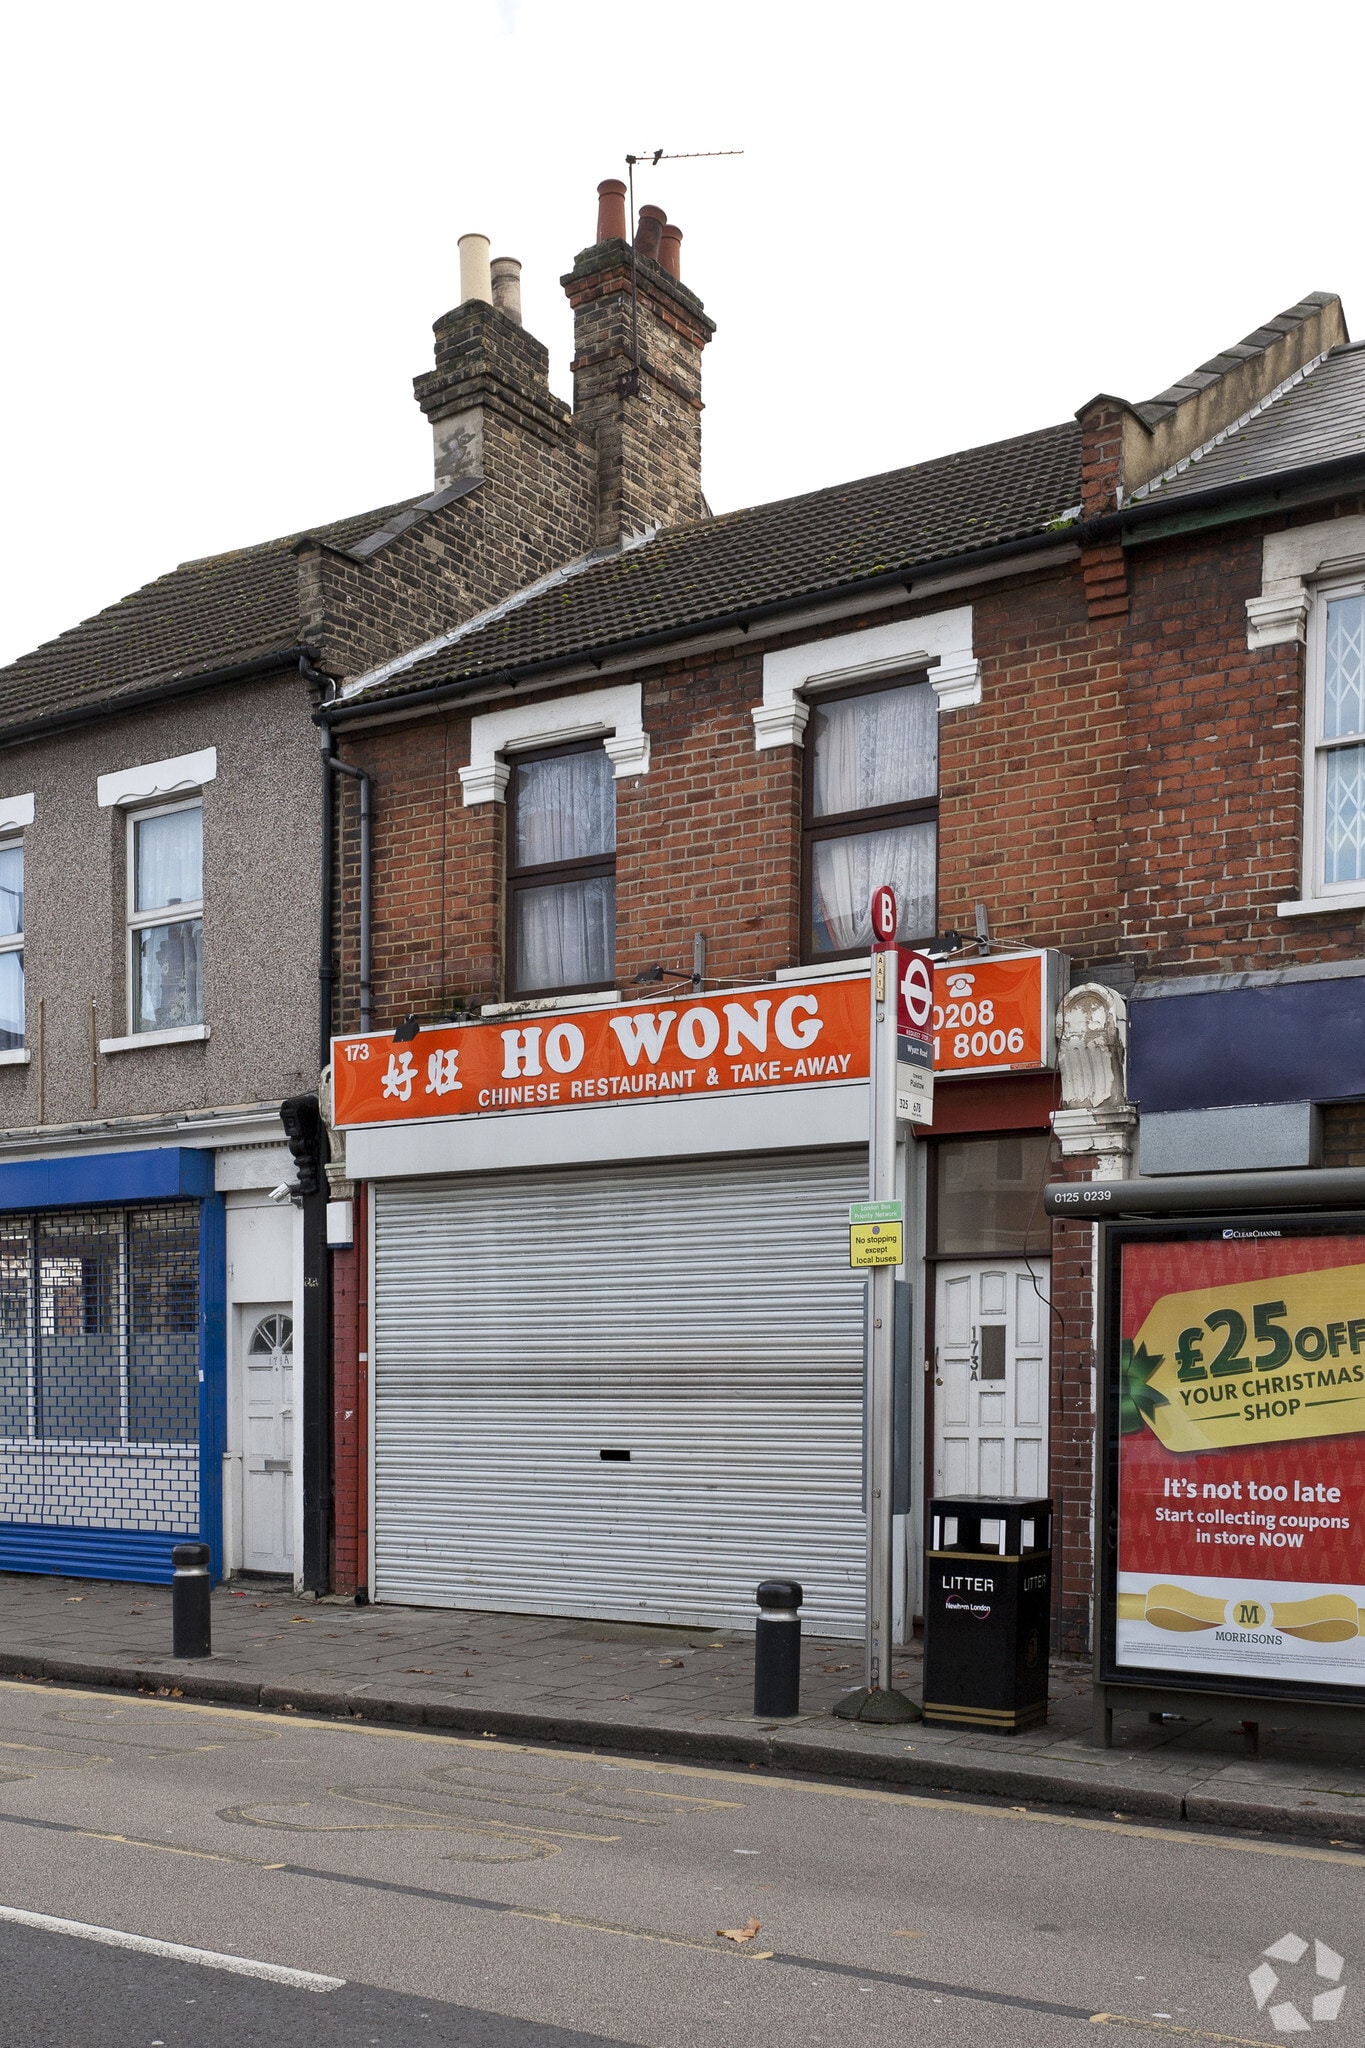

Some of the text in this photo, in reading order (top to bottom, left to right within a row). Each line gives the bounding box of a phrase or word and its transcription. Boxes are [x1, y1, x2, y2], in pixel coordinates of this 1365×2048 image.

[881, 892, 893, 933] B
[932, 999, 994, 1031] 0208
[501, 994, 824, 1079] HO WONG
[953, 1027, 1024, 1059] 8006
[345, 1043, 369, 1062] 173
[478, 1054, 852, 1107] CHINESE RESTAURANT & TAKE-AWAY
[899, 1099, 908, 1109] 325
[1054, 1190, 1111, 1203] 0125 0239
[855, 1235, 897, 1244] No stopping
[856, 1255, 897, 1264] local buses
[865, 1246, 888, 1255] except
[1175, 1300, 1292, 1382] £25
[970, 1325, 979, 1382] 173A
[1180, 1364, 1364, 1406] YOUR CHRISTMAS
[1244, 1398, 1301, 1421] SHOP
[1164, 1478, 1341, 1503] It's not too late
[1155, 1507, 1350, 1531] Start collecting coupons
[1196, 1529, 1304, 1548] in store NOW
[942, 1575, 994, 1592] LITTER
[1023, 1574, 1046, 1591] LITTER
[970, 1603, 991, 1612] London
[1239, 1604, 1260, 1625] M
[1215, 1631, 1283, 1646] MORRISONS
